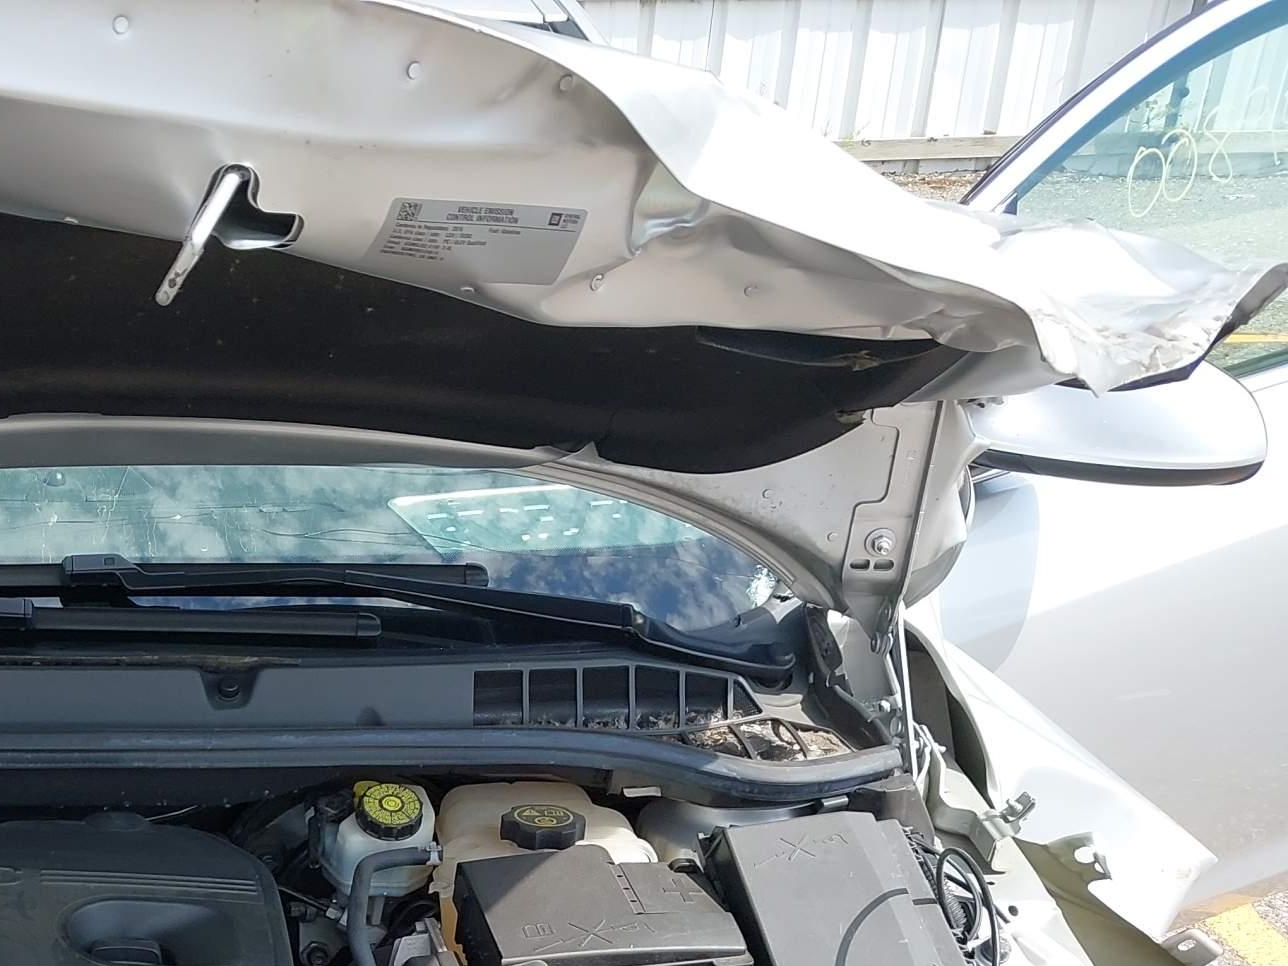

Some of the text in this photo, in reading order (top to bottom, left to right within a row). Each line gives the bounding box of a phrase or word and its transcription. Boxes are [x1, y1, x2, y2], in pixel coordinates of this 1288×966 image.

[457, 206, 514, 216] VEHICLE EMISSION
[446, 214, 519, 225] CONTROL INFORMATION
